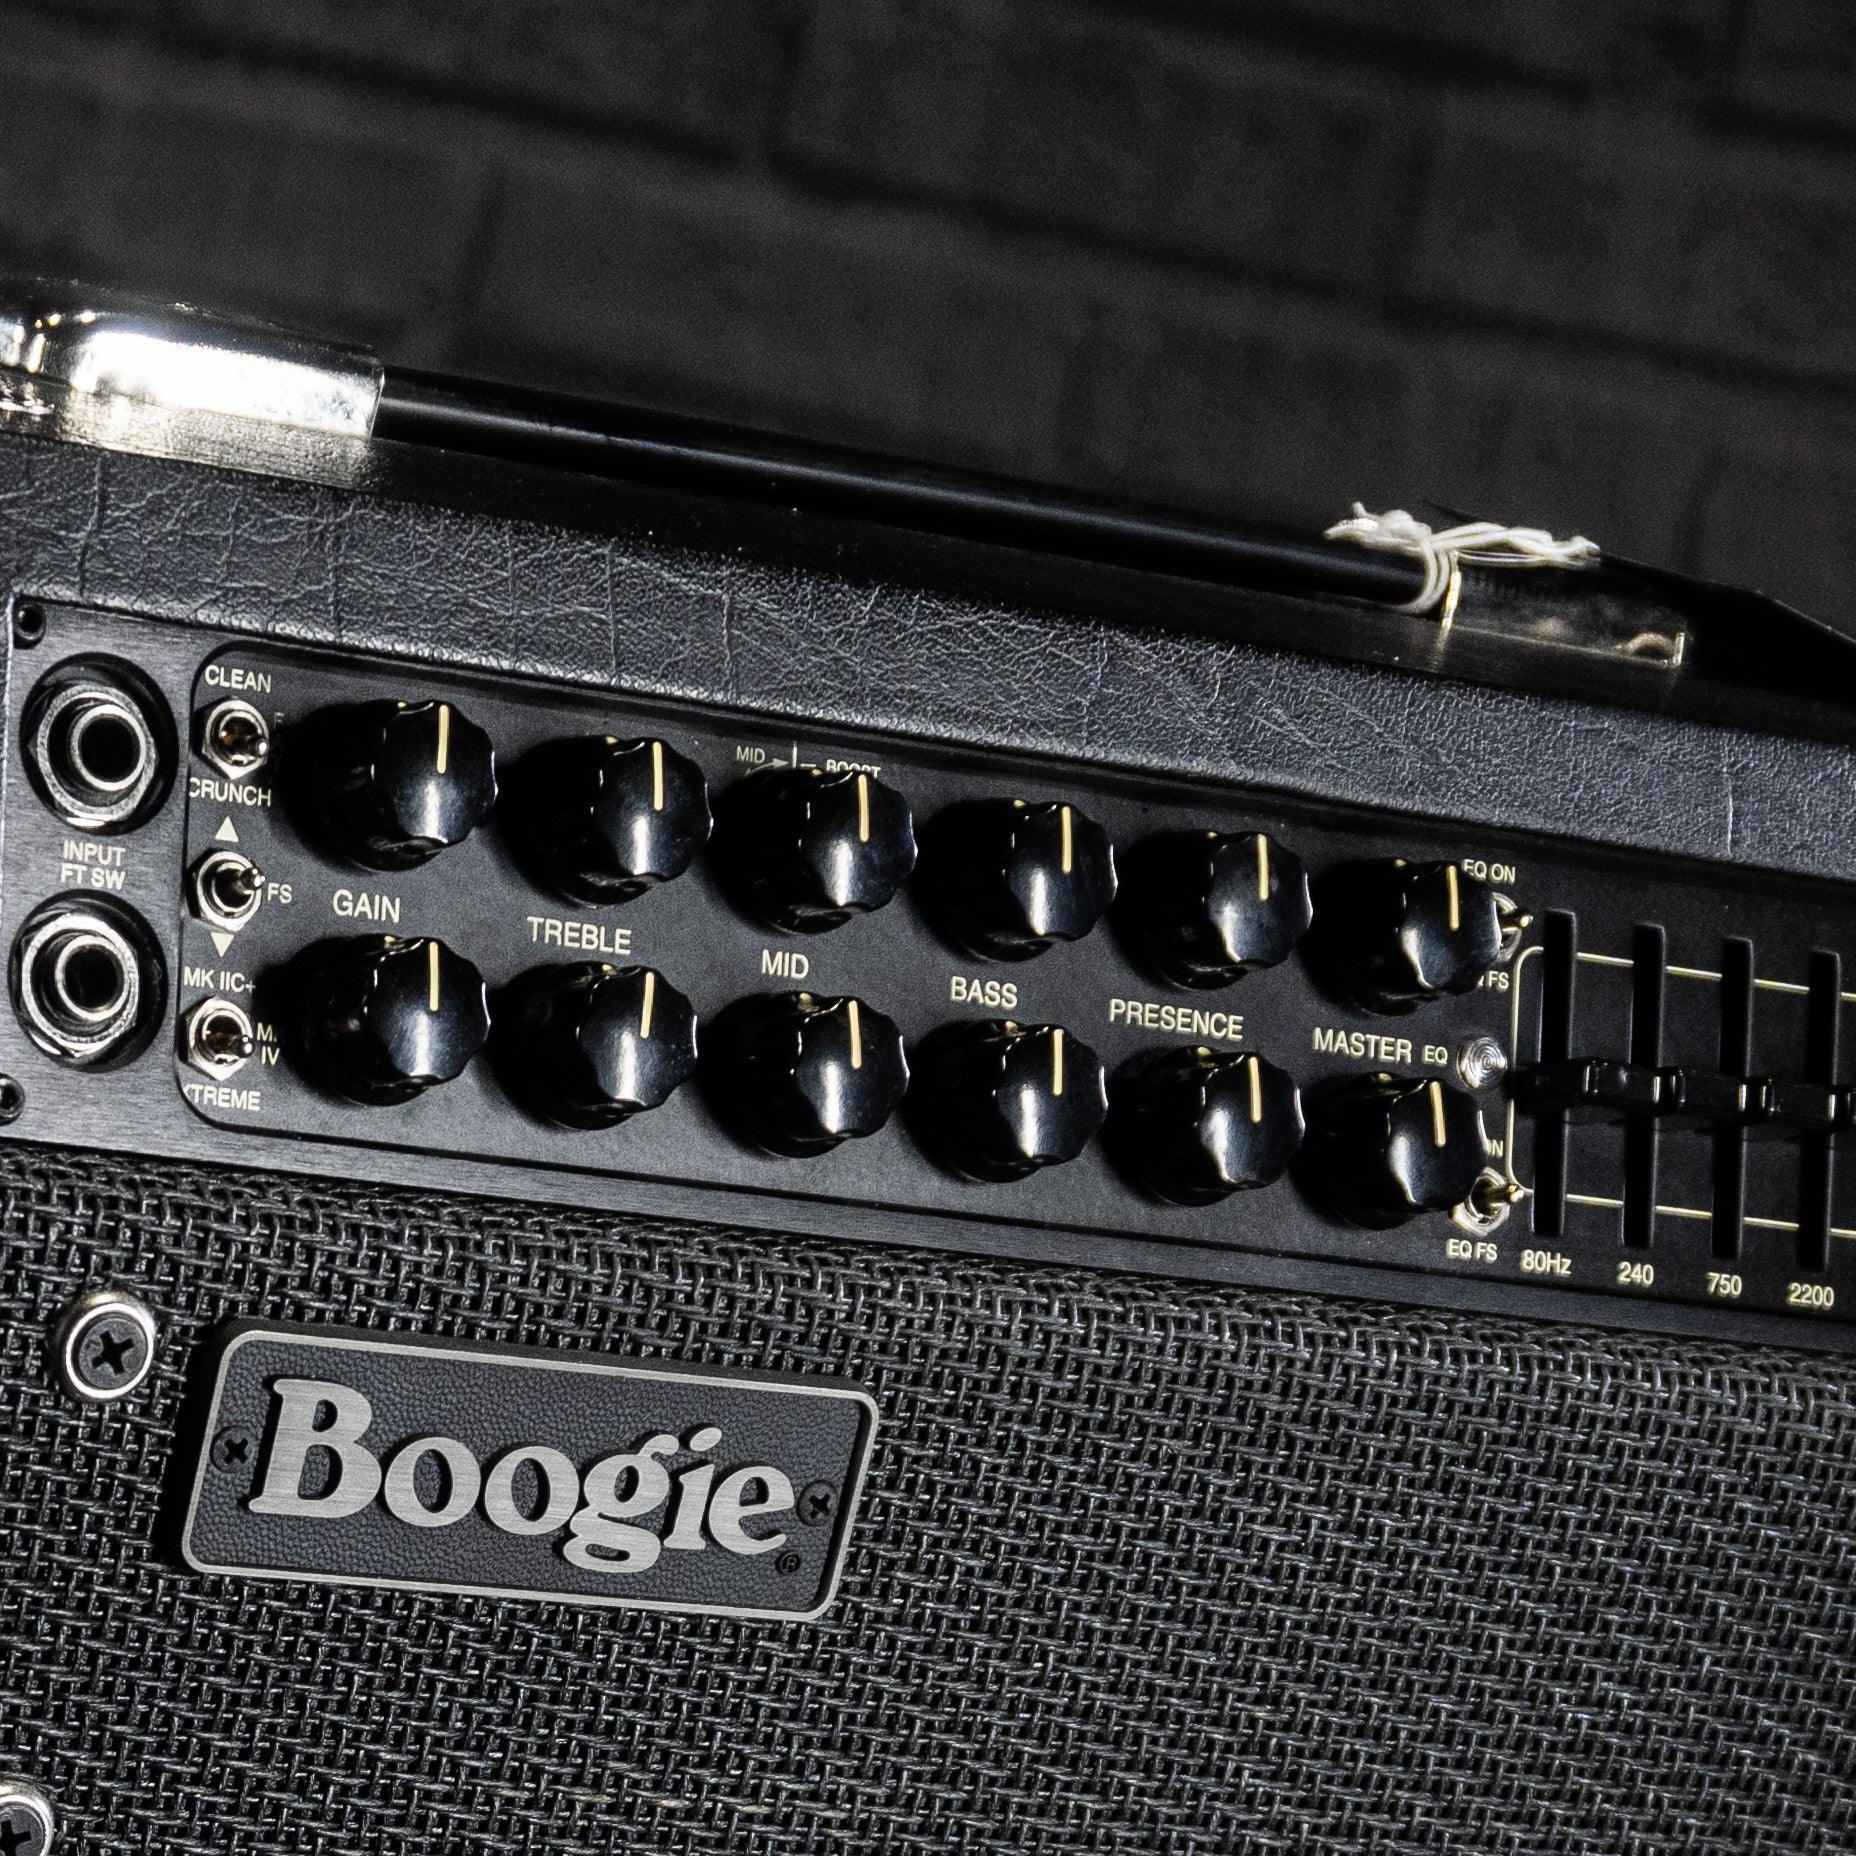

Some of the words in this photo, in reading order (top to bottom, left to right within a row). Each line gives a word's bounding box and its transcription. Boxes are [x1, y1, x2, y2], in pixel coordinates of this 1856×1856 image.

[204, 665, 272, 693] CLEAN
[736, 745, 766, 764] MID
[189, 776, 272, 807] CRUNCH
[62, 839, 127, 868] INPUT
[60, 863, 86, 885] FT
[90, 867, 126, 891] SW
[1462, 859, 1488, 880] EQ
[1490, 863, 1516, 884] ON
[267, 882, 293, 905] FS
[332, 889, 401, 924] GAIN
[527, 916, 632, 955] TREBLE
[760, 949, 810, 980] MID
[183, 966, 215, 990] MK
[219, 970, 257, 993] IIC+
[950, 975, 1018, 1009] BASS
[1488, 970, 1510, 990] FS
[256, 1022, 278, 1043] M
[1110, 999, 1244, 1040] PRESENCE
[261, 1046, 281, 1066] IV
[1314, 1026, 1413, 1065] MASTER
[1423, 1044, 1449, 1066] EQ
[1446, 1238, 1473, 1261] EQ
[1475, 1242, 1499, 1263] FS
[1521, 1249, 1572, 1275] 80Hz
[1618, 1261, 1655, 1286] 240
[1707, 1271, 1743, 1297] 750
[1787, 1282, 1836, 1307] 2200
[249, 1378, 795, 1573] Boogie
